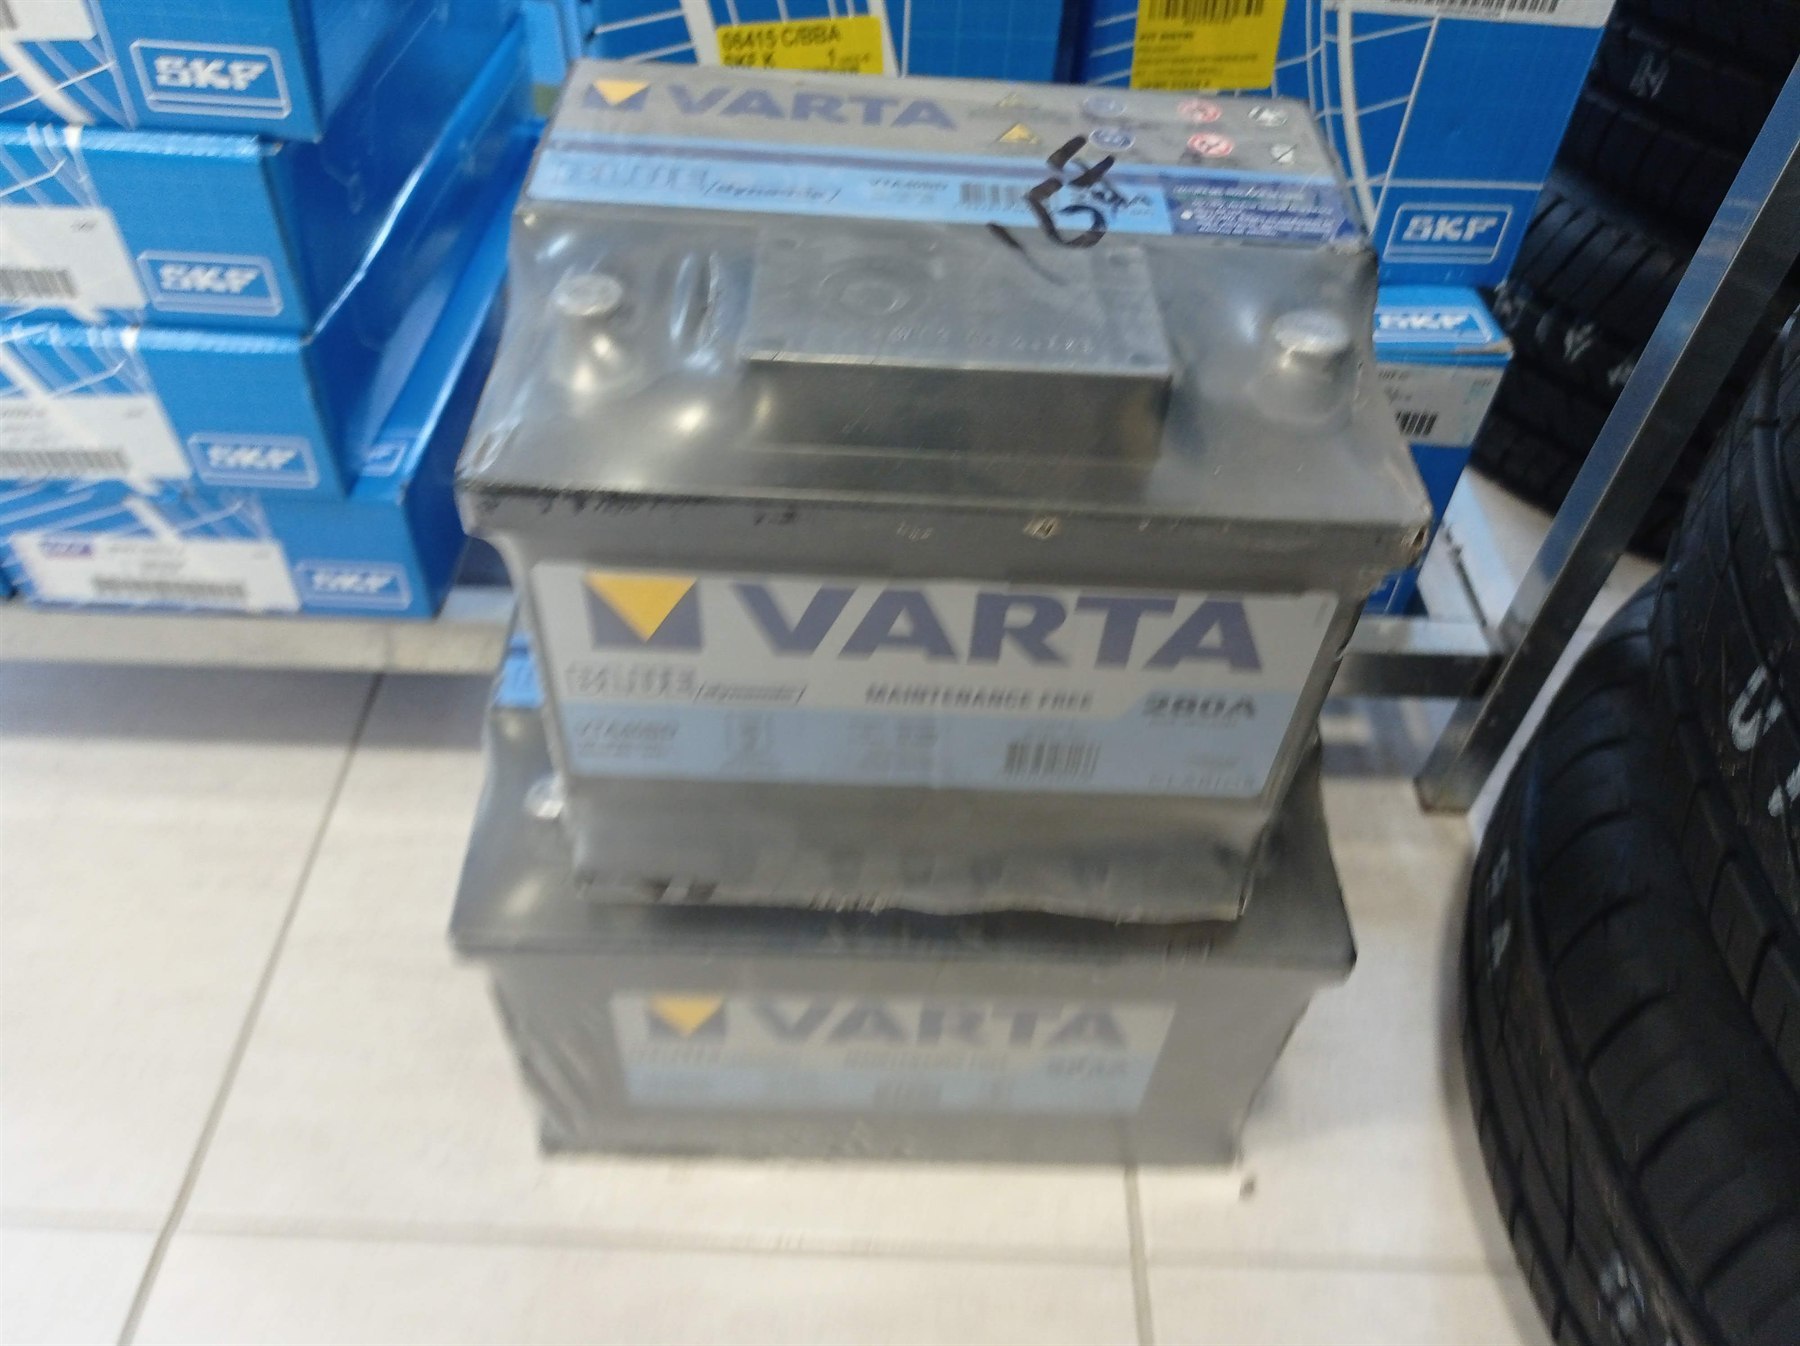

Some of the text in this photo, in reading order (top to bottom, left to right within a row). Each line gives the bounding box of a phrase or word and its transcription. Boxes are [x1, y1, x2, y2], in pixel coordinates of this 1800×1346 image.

[154, 56, 268, 91] SKF
[668, 83, 958, 132] VARTA
[1402, 214, 1498, 243] SKF
[158, 263, 261, 295] SKF
[731, 580, 1263, 673] VARTA
[864, 681, 1095, 714] MAINTENANCE FREE
[749, 998, 1129, 1049] VARTA
